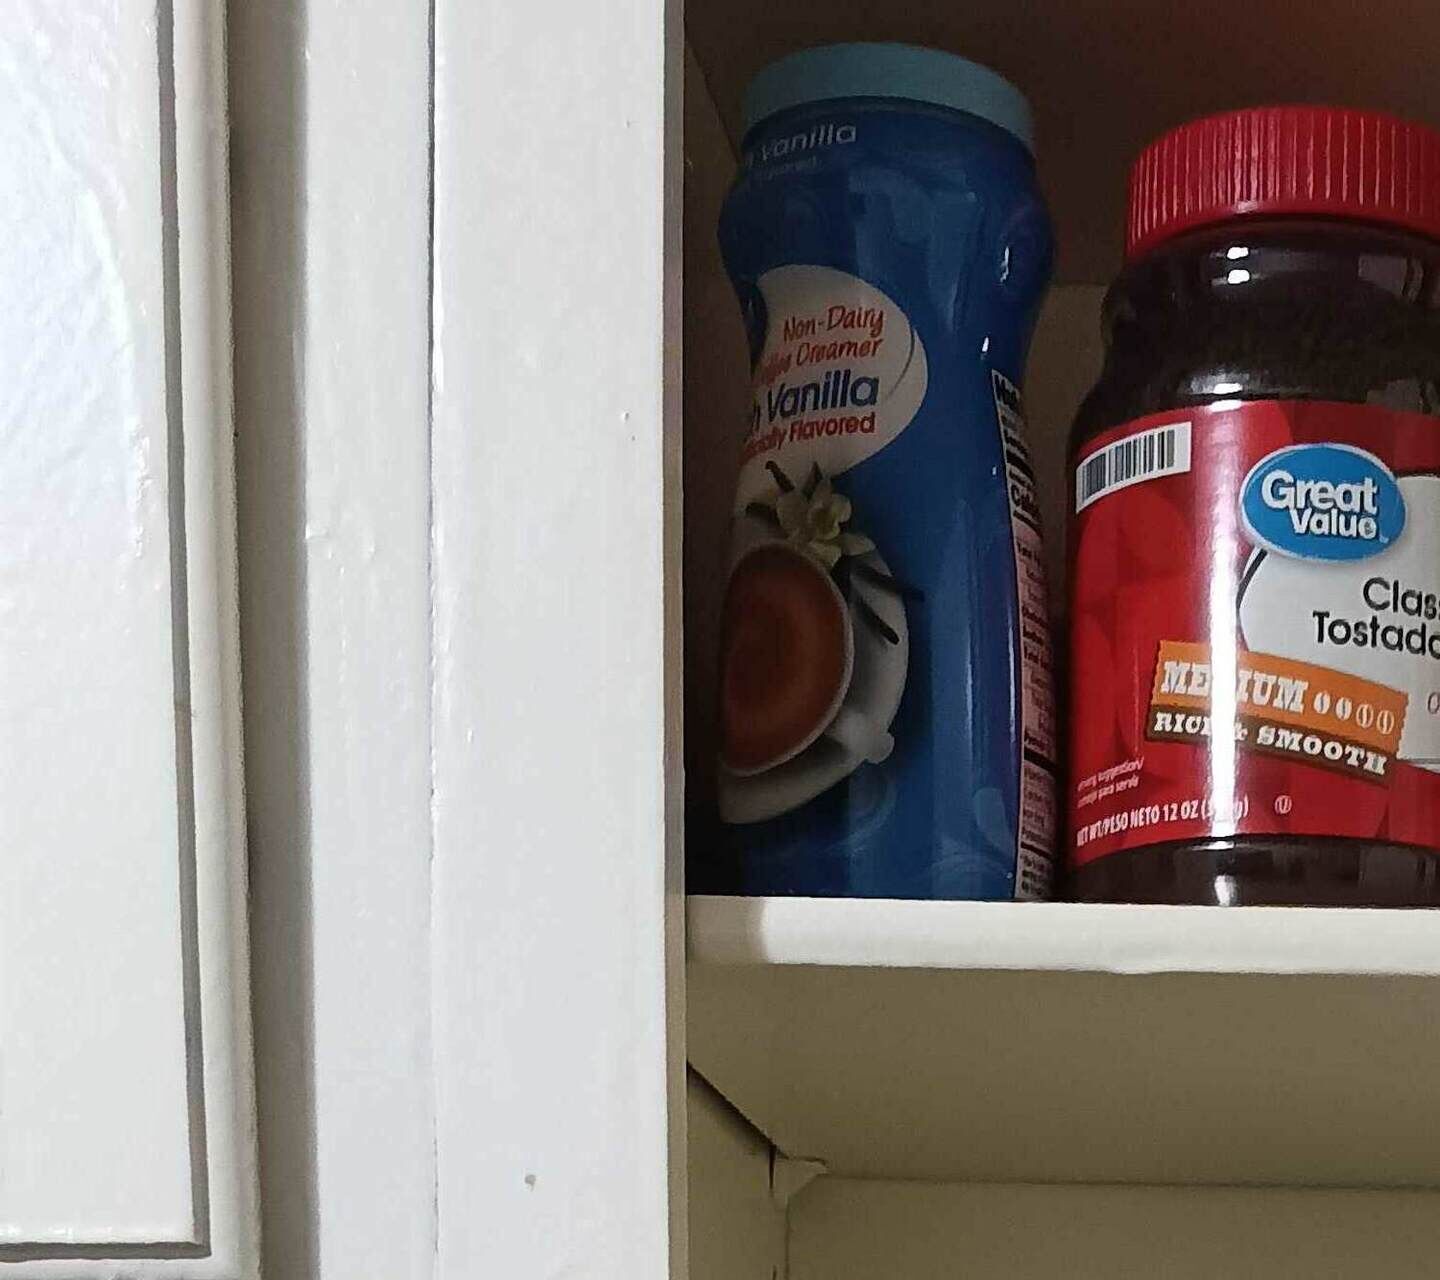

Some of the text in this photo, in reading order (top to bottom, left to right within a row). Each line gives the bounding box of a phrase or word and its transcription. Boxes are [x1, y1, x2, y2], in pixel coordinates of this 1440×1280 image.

[783, 304, 884, 342] Non-Dairy
[767, 369, 880, 422] Vanilla
[789, 411, 876, 442] Flavored
[1261, 469, 1379, 515] Great
[1289, 507, 1378, 540] Value
[1159, 658, 1311, 714] MEIUM
[1256, 724, 1389, 776] SMOOTH
[1129, 802, 1161, 830] NETO
[1162, 801, 1179, 823] 12
[1179, 798, 1200, 821] OZ
